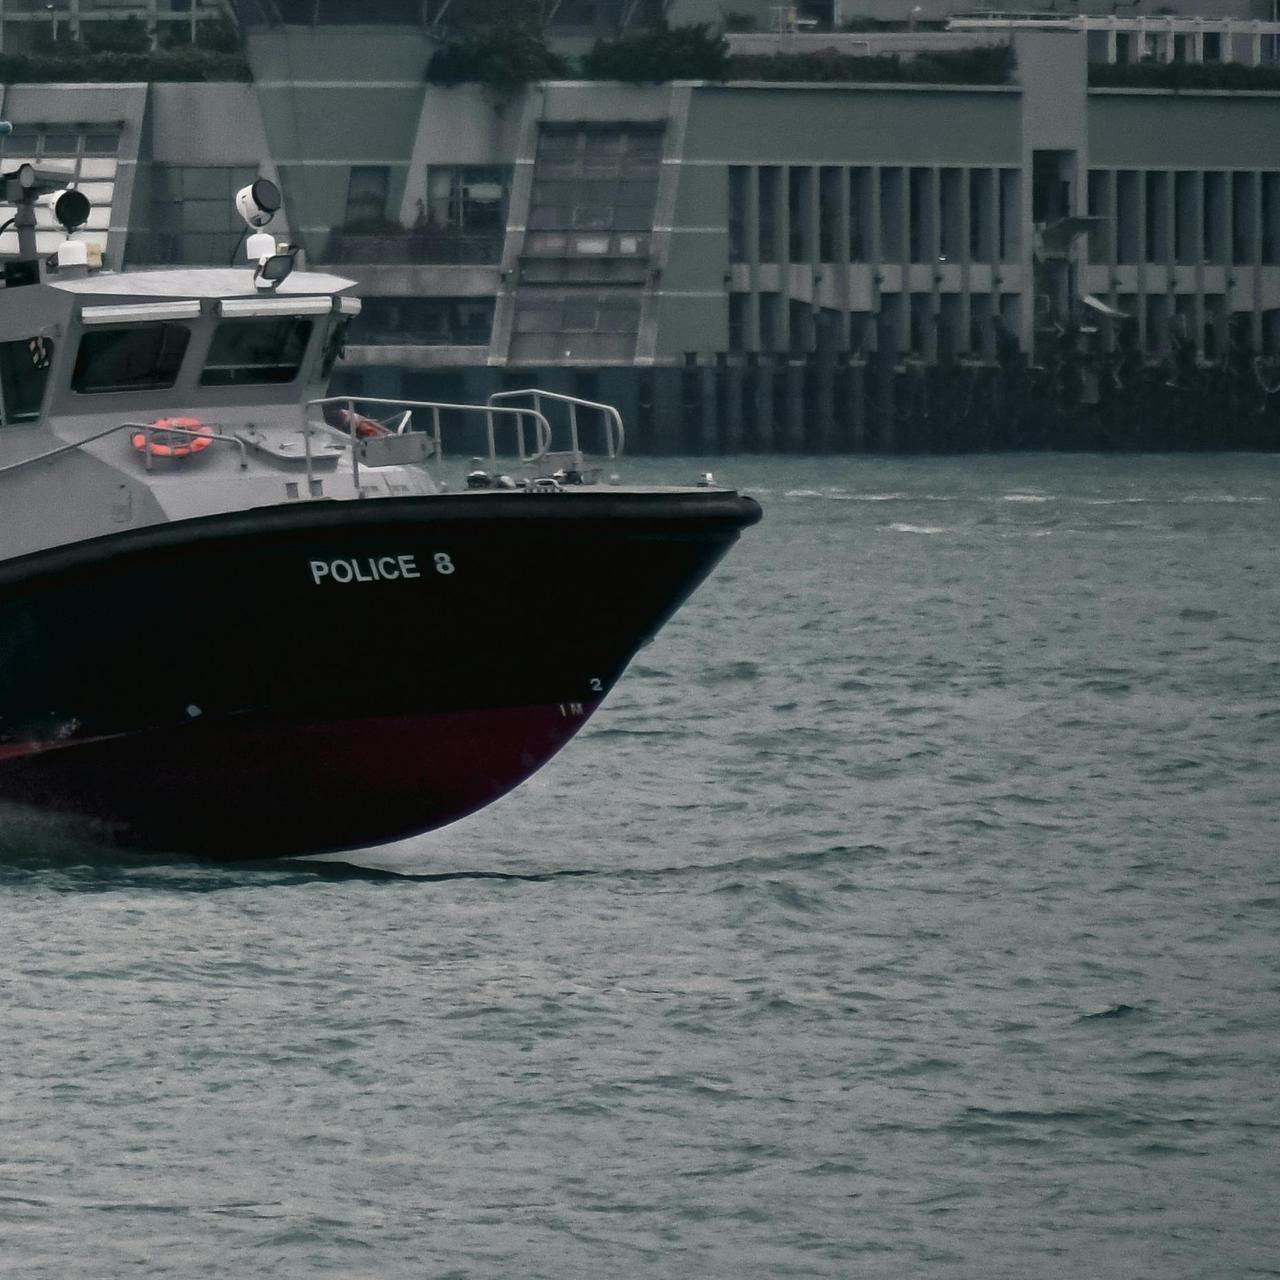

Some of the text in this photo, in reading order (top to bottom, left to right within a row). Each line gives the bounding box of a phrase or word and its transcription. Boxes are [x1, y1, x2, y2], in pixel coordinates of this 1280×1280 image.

[309, 552, 455, 585] POLICE 8
[589, 677, 603, 692] 2
